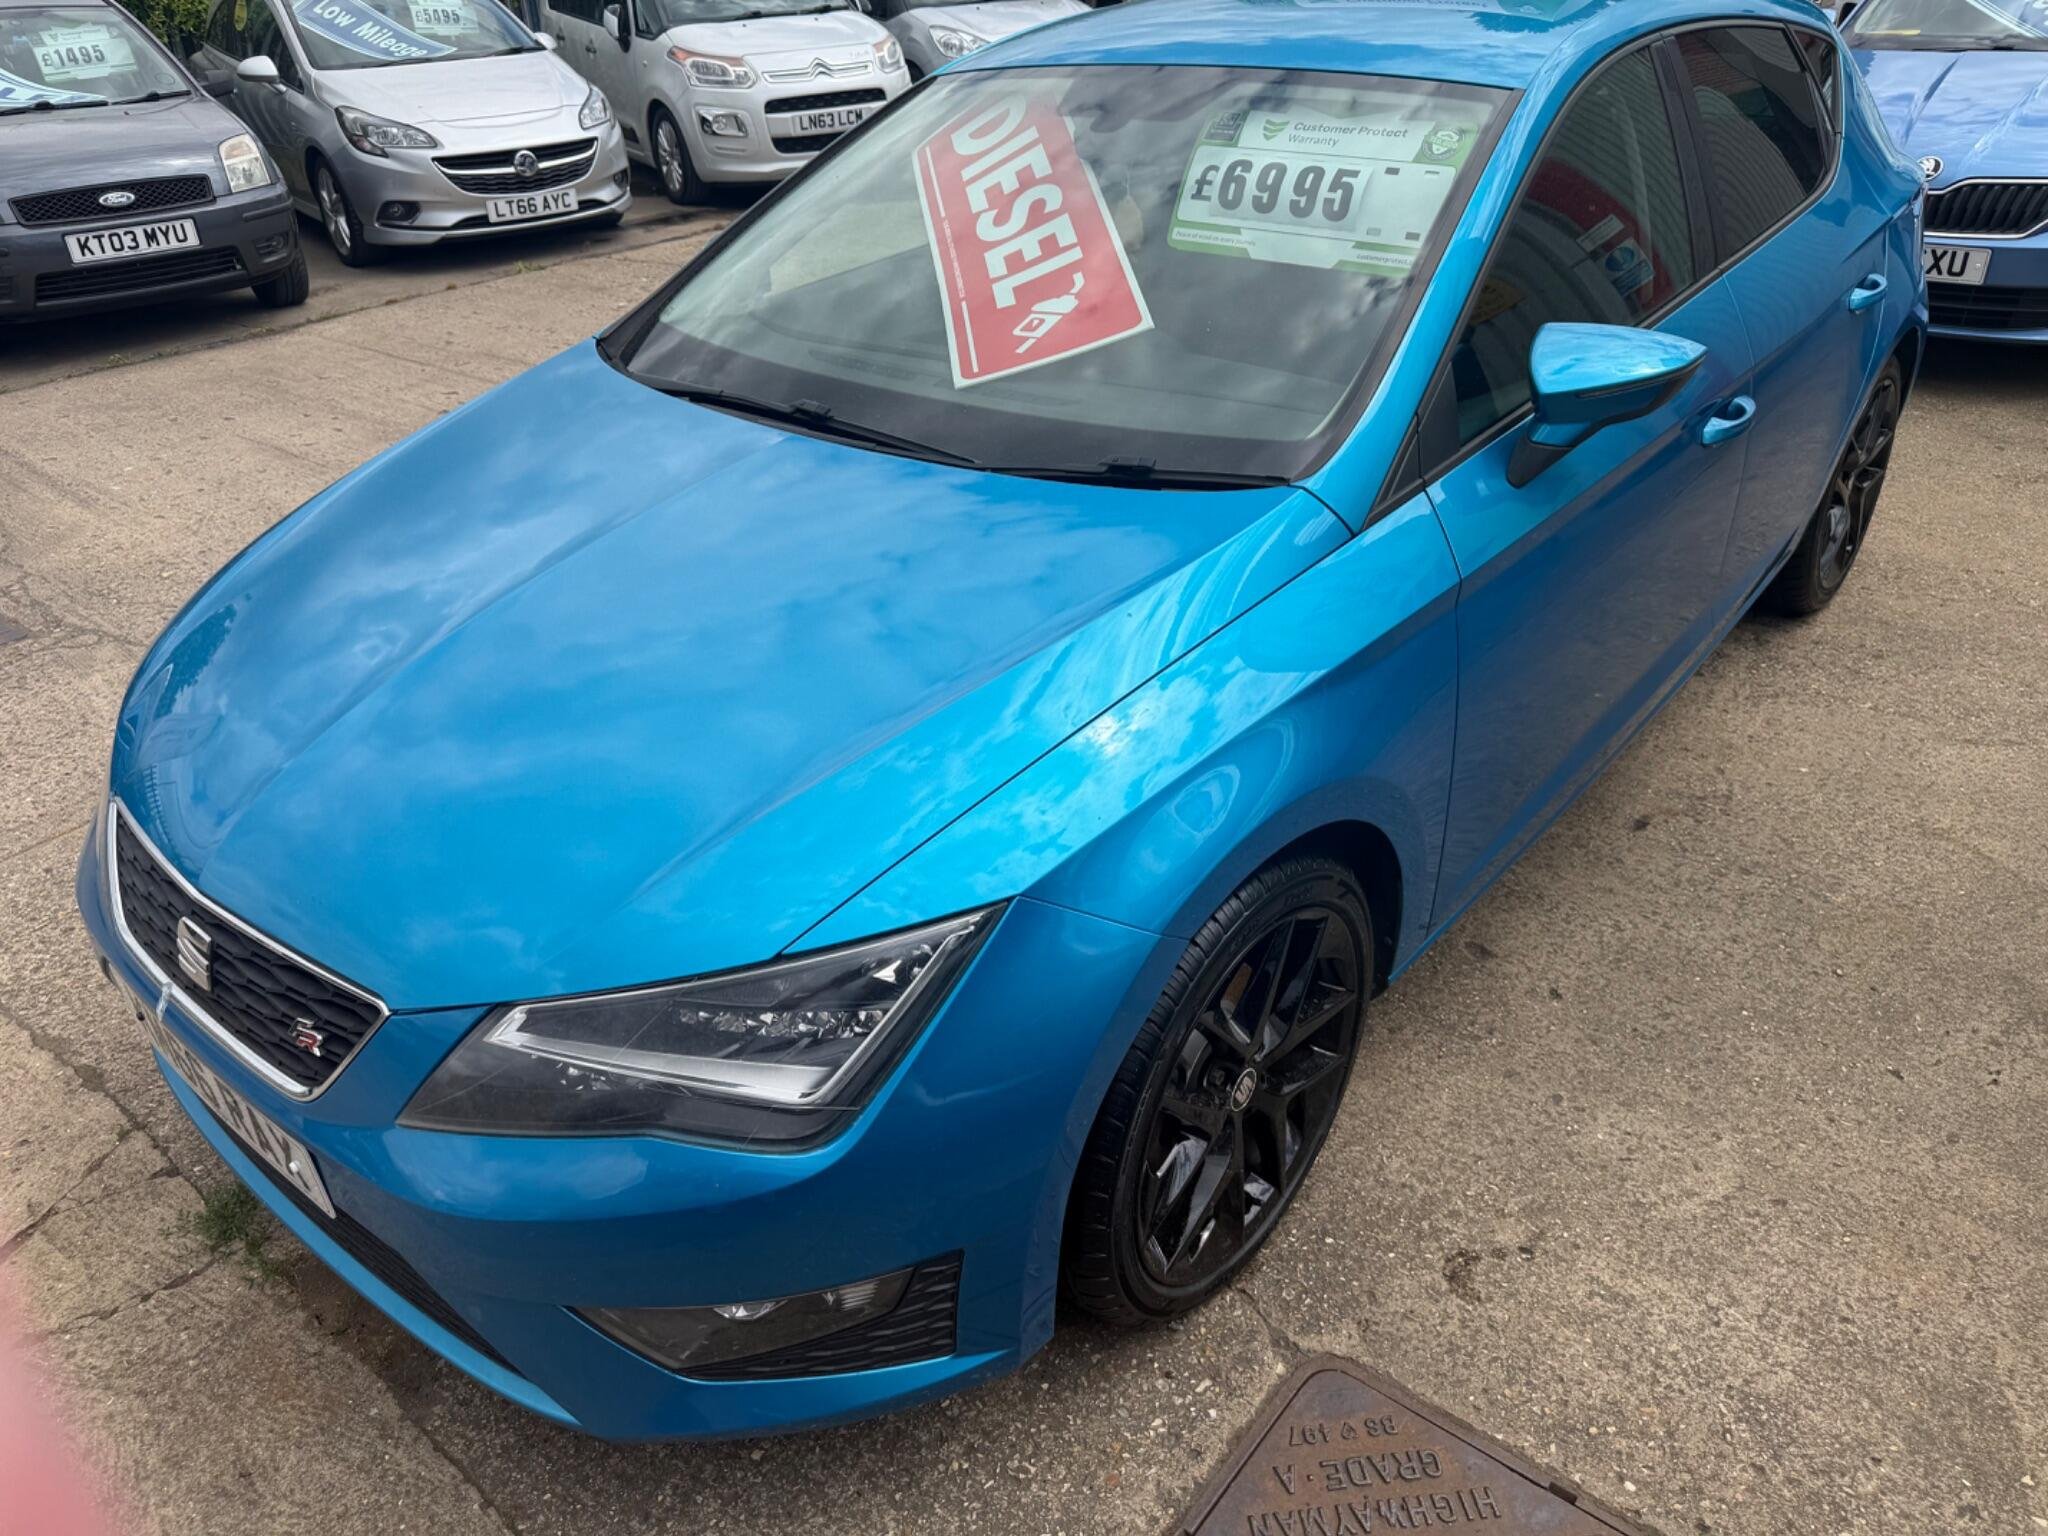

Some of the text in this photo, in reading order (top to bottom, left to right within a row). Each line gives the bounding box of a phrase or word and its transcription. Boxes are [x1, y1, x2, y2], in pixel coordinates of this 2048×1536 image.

[313, 0, 429, 57] Low Mileage
[41, 44, 106, 67] £1495
[800, 112, 836, 131] LN63
[1293, 121, 1409, 139] Customer Protect
[1287, 133, 1340, 148] Warranty
[494, 192, 572, 218] LT66 AYC
[950, 95, 1083, 309] DIESEL
[1190, 158, 1361, 222] £6995
[76, 223, 189, 257] KT03 MYU
[1364, 1414, 1399, 1437] BS
[1271, 1449, 1442, 1495] GRADE A
[1247, 1486, 1502, 1536] HIGHWAYMAN
